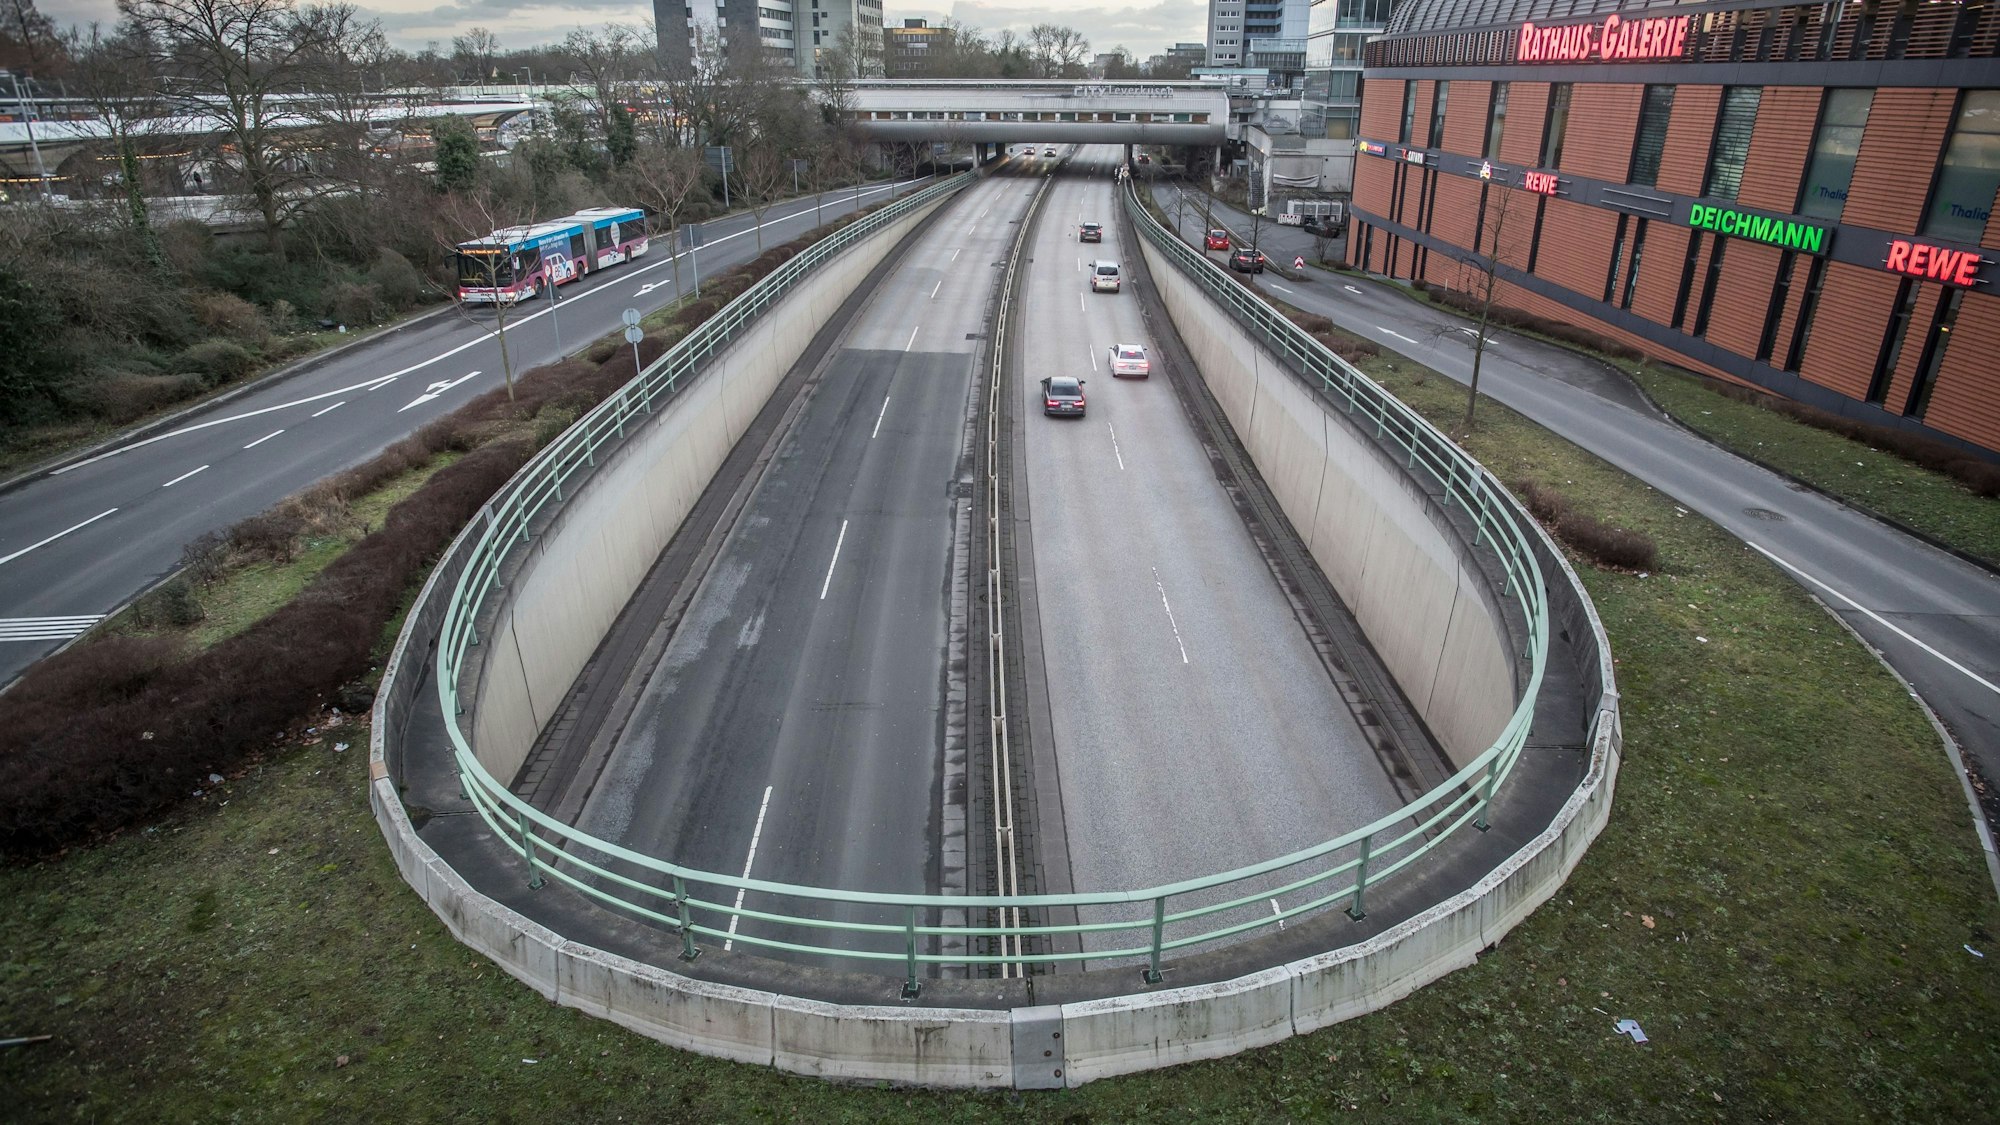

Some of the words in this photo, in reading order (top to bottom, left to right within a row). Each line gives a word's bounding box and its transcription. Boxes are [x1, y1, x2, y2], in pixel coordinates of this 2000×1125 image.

[1517, 14, 1689, 61] RATHAUS-GALERIE
[1525, 171, 1558, 195] REWE
[1820, 186, 1848, 200] Thalia
[1951, 204, 1989, 221] Thalia
[1689, 203, 1824, 252] DEICHMANN
